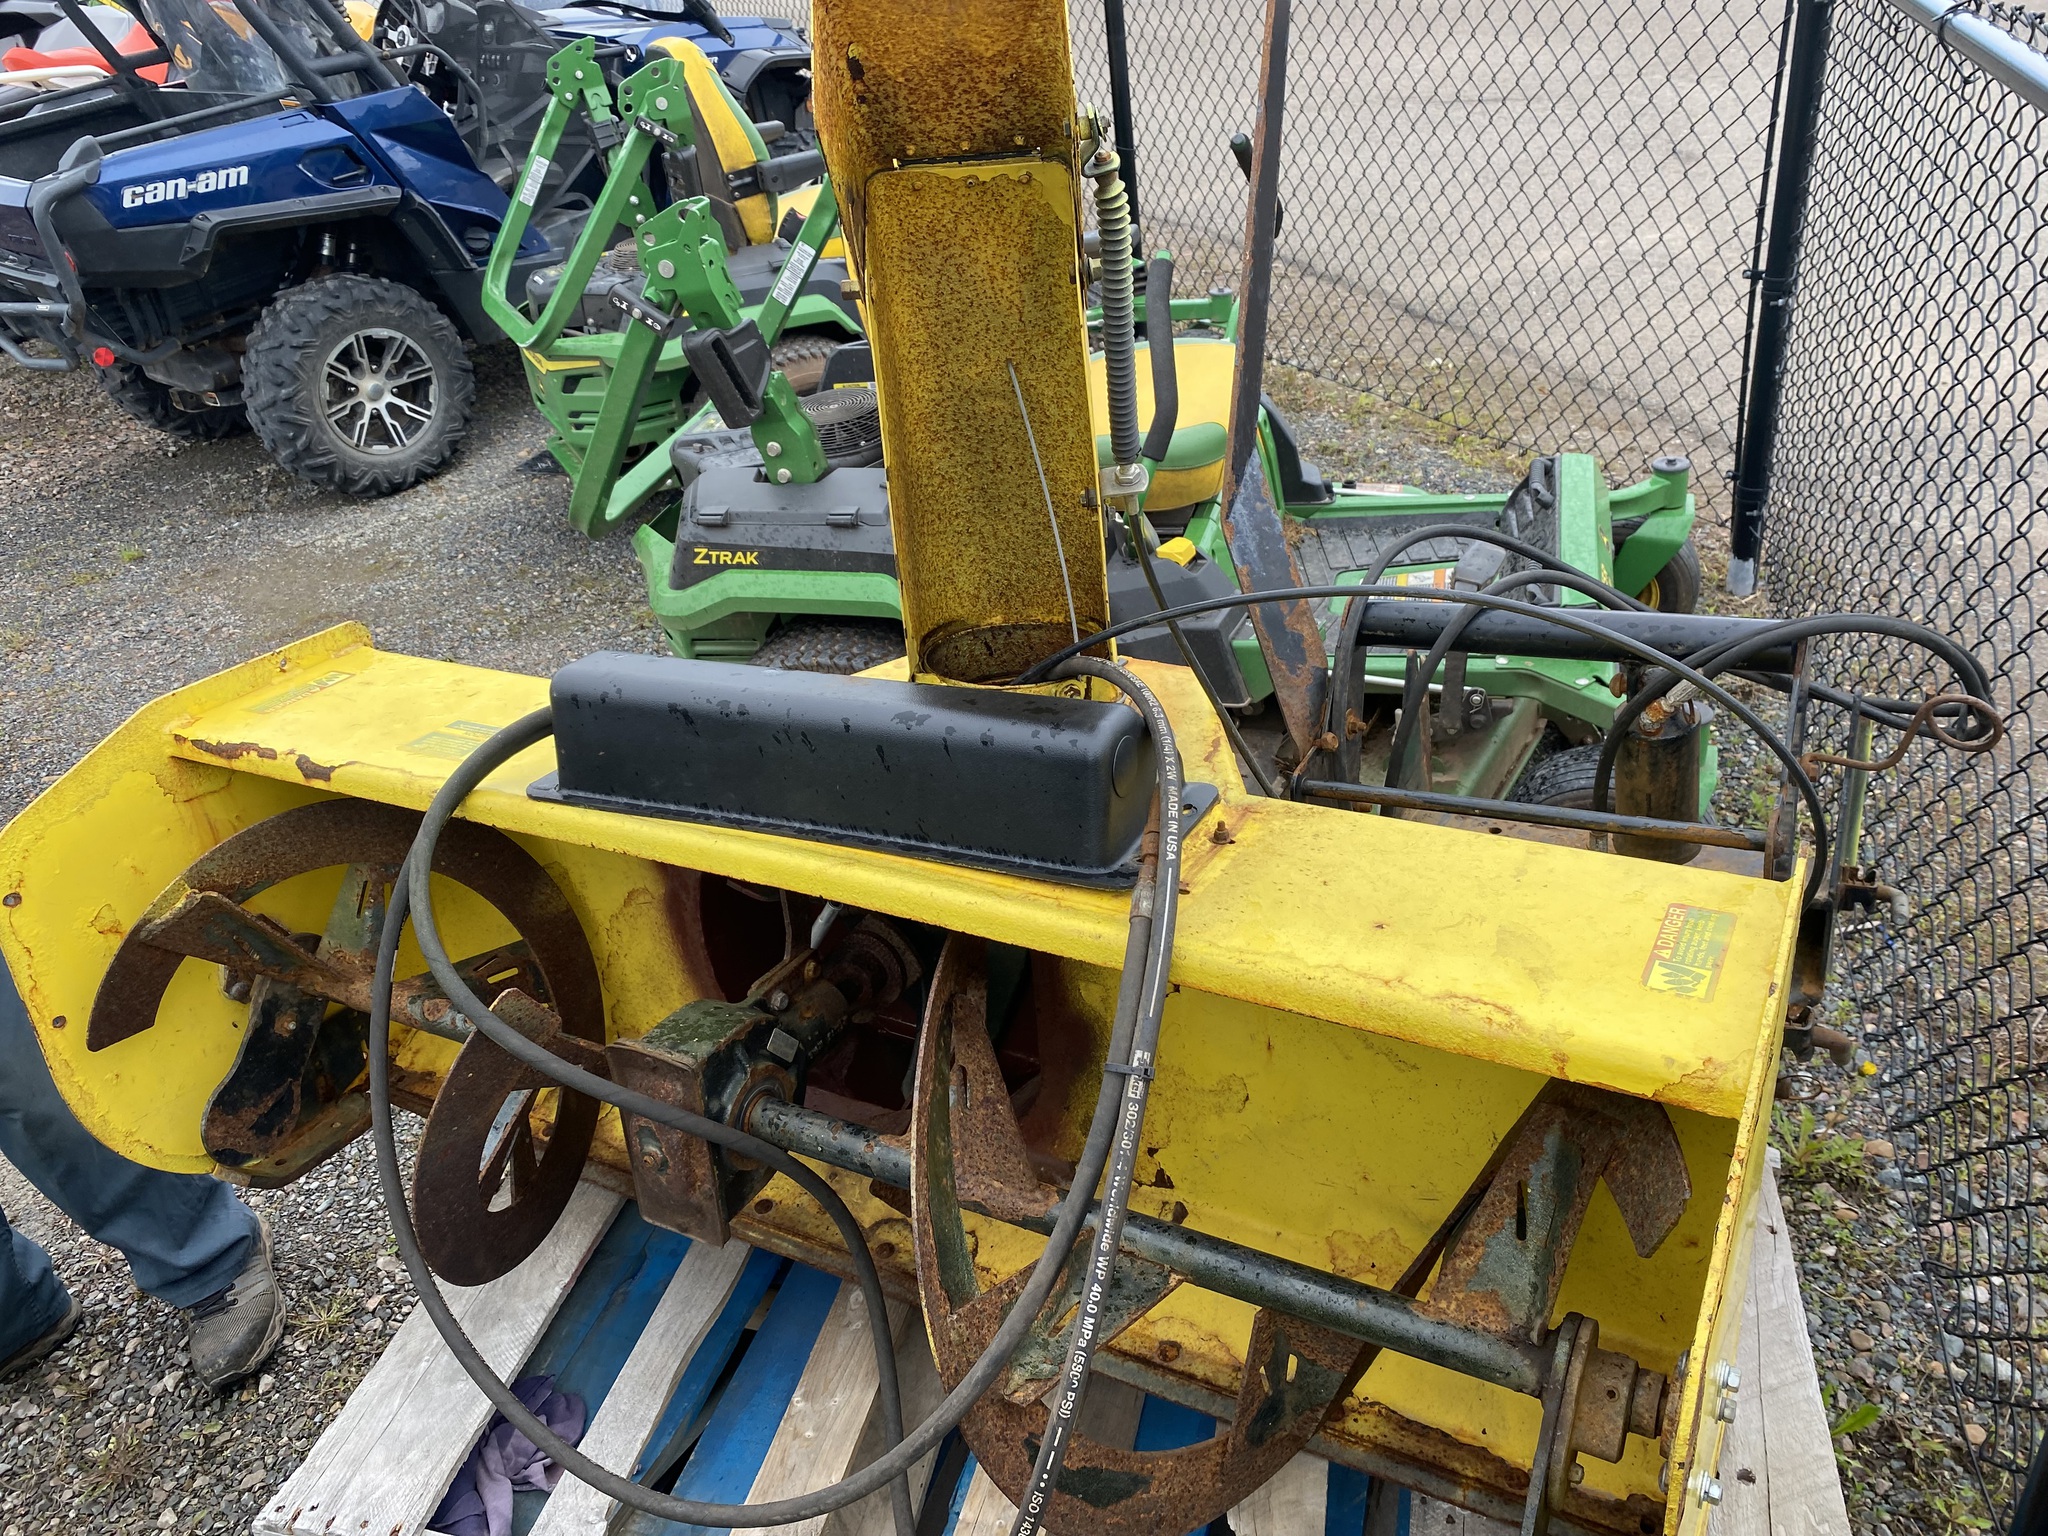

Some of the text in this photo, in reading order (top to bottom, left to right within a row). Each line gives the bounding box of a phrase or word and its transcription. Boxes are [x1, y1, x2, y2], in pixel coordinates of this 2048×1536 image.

[122, 165, 249, 209] can-am
[693, 548, 759, 565] ZTRAK
[1165, 785, 1179, 861] MADE IN USA
[1656, 907, 1687, 948] DANGER
[1095, 1256, 1110, 1280] WP
[1086, 1282, 1102, 1314] 40,0
[1077, 1315, 1096, 1348] MPa
[1028, 1490, 1045, 1514] ISO
